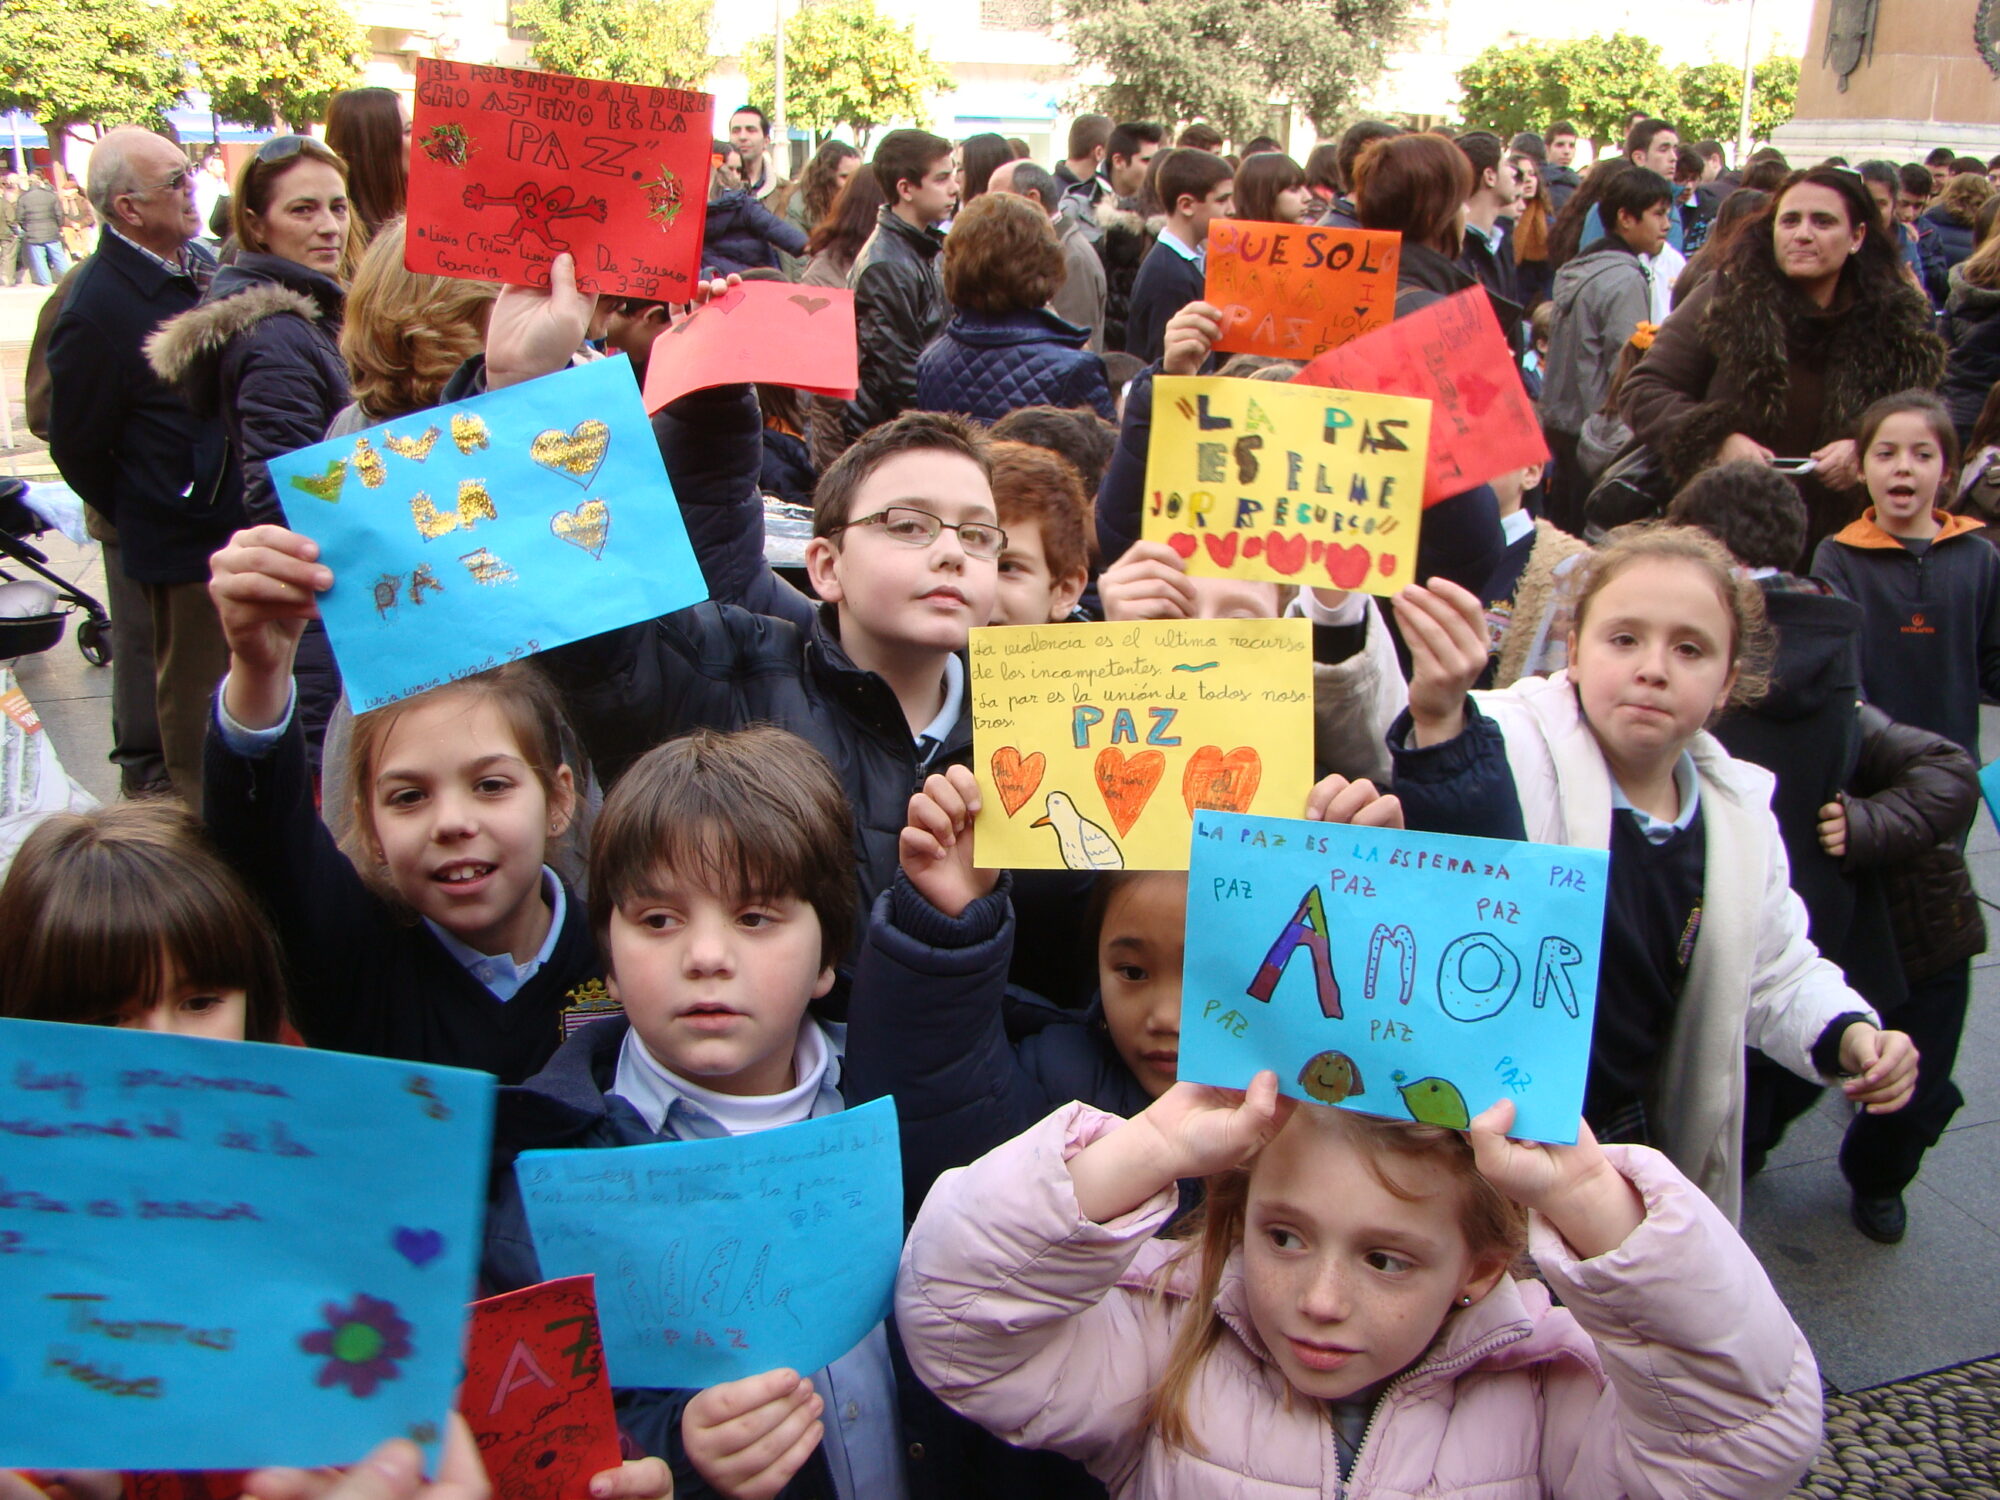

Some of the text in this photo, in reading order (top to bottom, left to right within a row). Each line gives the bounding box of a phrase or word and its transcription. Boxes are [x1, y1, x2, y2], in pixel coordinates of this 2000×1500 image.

[471, 66, 591, 99] RESPETO
[597, 86, 637, 104] AL
[418, 82, 470, 108] CHO
[480, 90, 594, 126] AJENO
[597, 243, 619, 273] De
[1212, 224, 1396, 274] QUE SOLO
[1196, 434, 1265, 486] ES
[1004, 631, 1087, 656] violencia
[1094, 635, 1114, 647] es
[1121, 627, 1141, 649] el
[1228, 636, 1306, 652] recurso
[972, 663, 995, 680] de
[1000, 661, 1026, 681] los
[1046, 691, 1066, 704] es
[1072, 682, 1093, 703] la
[1165, 684, 1189, 701] de
[1197, 680, 1253, 701] todos
[1071, 704, 1183, 749] PAZ
[1198, 822, 1224, 841] LA
[1240, 829, 1287, 848] PAZ
[1305, 834, 1330, 854] ES
[1352, 843, 1379, 862] LA
[1213, 877, 1253, 902] PAZ
[1330, 868, 1377, 898] PAZ
[1550, 864, 1588, 893] PAZ
[1476, 897, 1522, 925] PAZ
[1246, 884, 1583, 1024] AMOR
[1202, 1000, 1250, 1040] PAZ
[1370, 1019, 1414, 1042] PAZ
